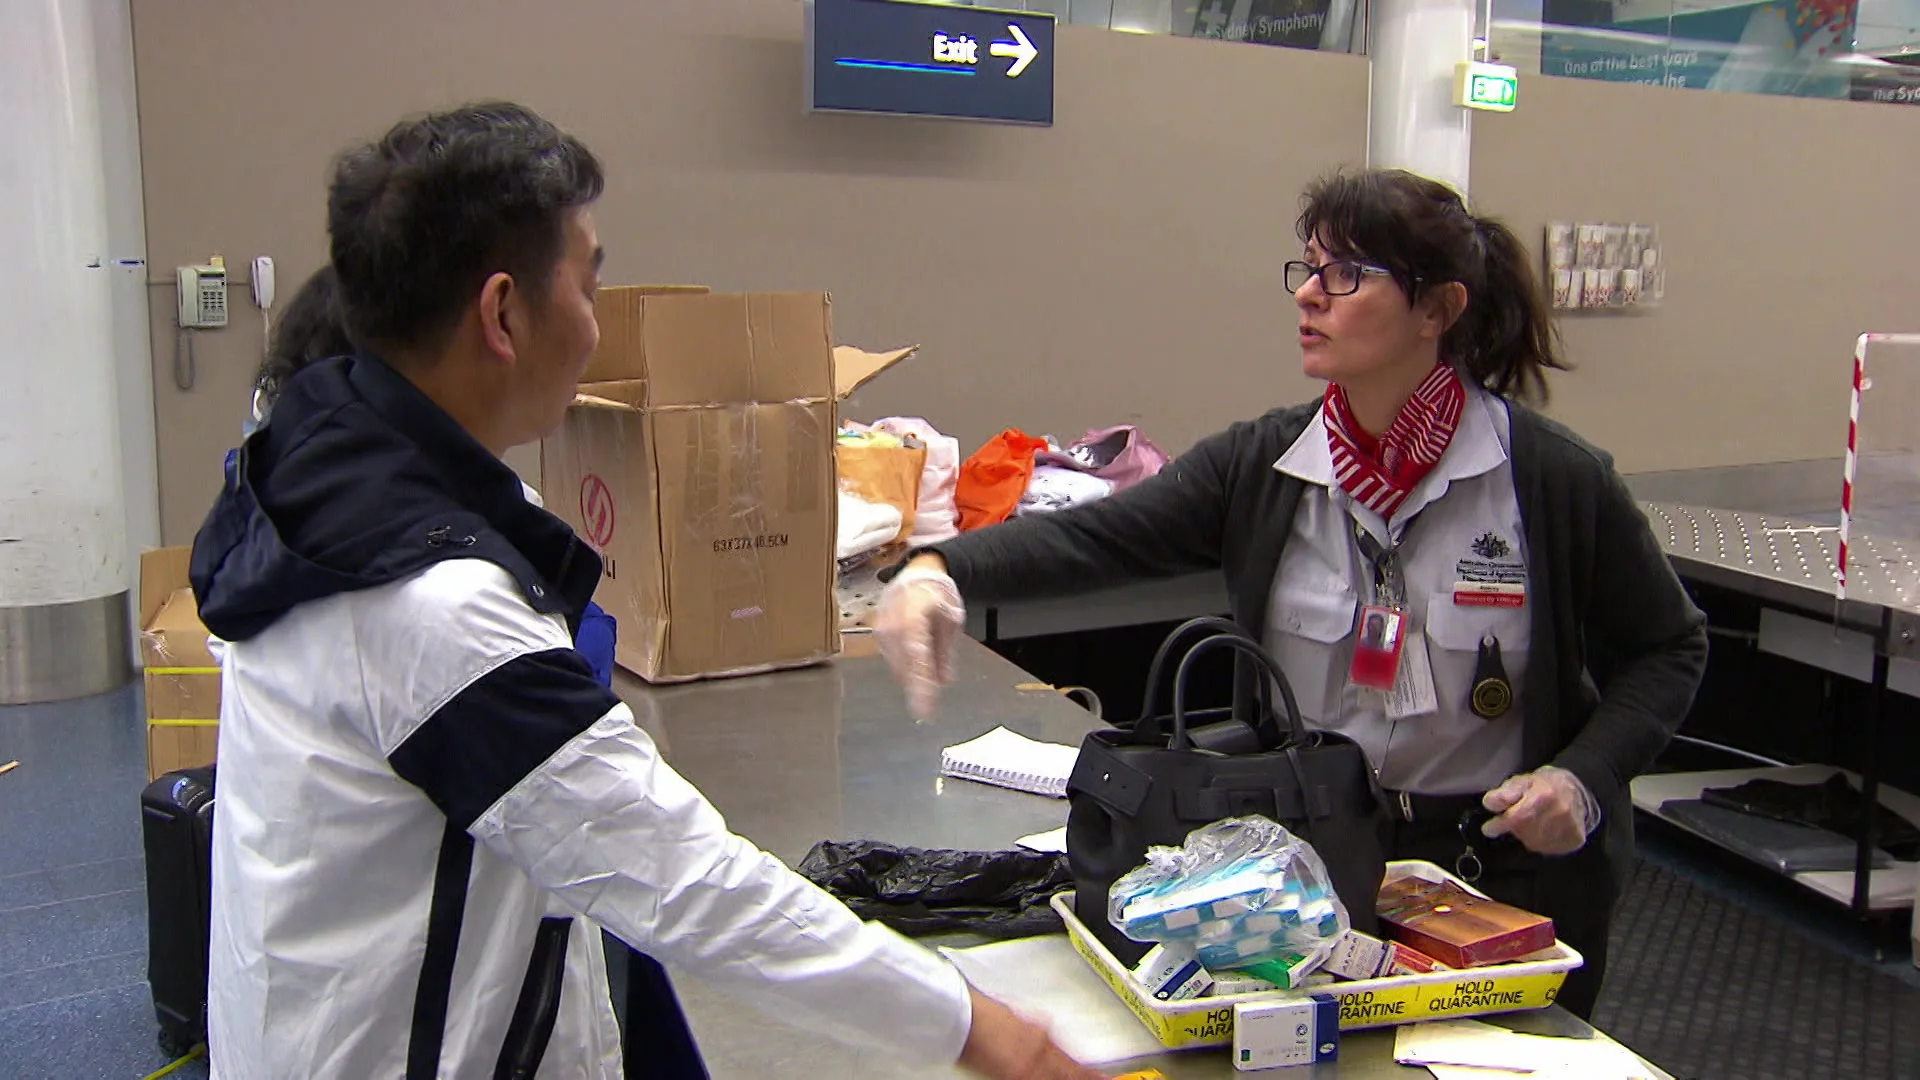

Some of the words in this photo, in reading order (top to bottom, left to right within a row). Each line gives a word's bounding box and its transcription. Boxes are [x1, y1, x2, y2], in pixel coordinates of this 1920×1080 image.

[1259, 11, 1326, 37] Symphony
[933, 32, 979, 64] Exit
[1564, 58, 1588, 74] One
[1604, 55, 1627, 71] the
[1629, 52, 1660, 70] best
[1662, 50, 1698, 68] ways
[1454, 979, 1495, 996] HOLD
[1340, 1000, 1407, 1020] RANTINE
[1429, 989, 1525, 1012] QUARANTINE
